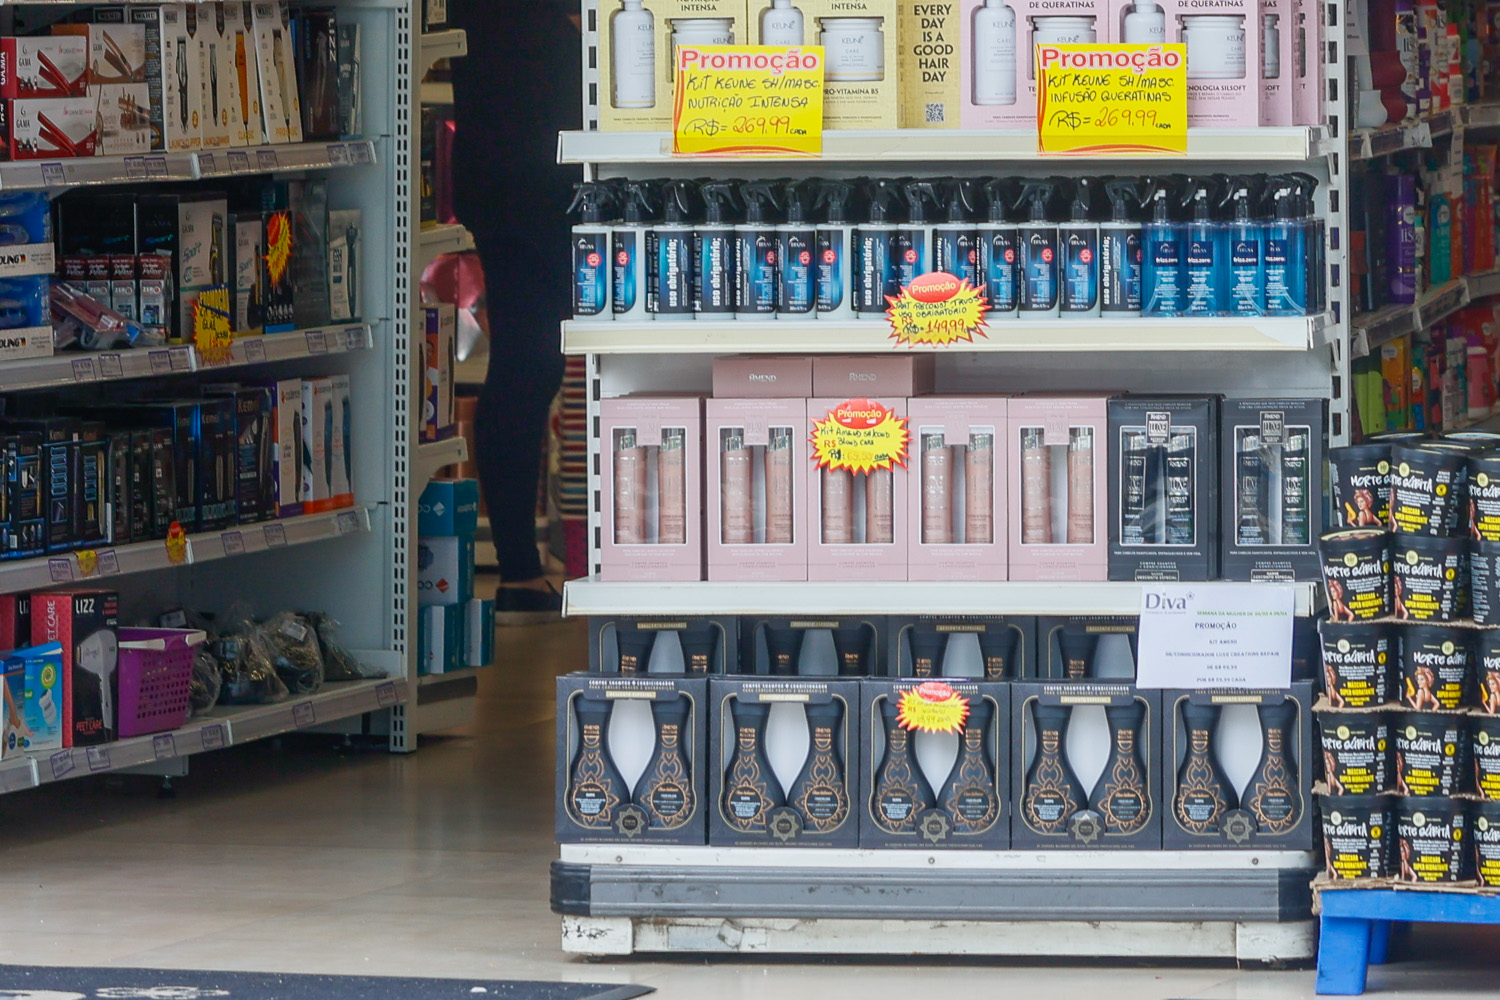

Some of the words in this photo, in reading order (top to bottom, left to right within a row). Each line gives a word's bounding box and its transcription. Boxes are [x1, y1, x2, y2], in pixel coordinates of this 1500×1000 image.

[914, 4, 951, 16] EVERY
[1029, 1, 1039, 9] DE
[1041, 0, 1095, 10] QUERATINAS
[1178, 0, 1188, 8] DE
[1190, 0, 1244, 9] QUERATINAS
[921, 18, 945, 29] DAY
[923, 32, 933, 42] IS
[935, 32, 944, 42] A
[913, 44, 954, 56] GOOD
[681, 50, 817, 74] Promoção
[919, 57, 949, 69] HAIR
[1042, 48, 1179, 72] Promoção
[922, 71, 946, 82] DAY
[1072, 74, 1111, 87] KEUNE
[714, 77, 756, 89] KEUNE
[1051, 87, 1097, 102] INFUSÃO
[748, 96, 808, 109] INTENSA
[912, 282, 956, 294] Promoção
[837, 409, 882, 419] Promoção
[824, 440, 836, 448] R$
[75, 598, 95, 614] LIZZ
[1145, 593, 1186, 609] Diva
[1195, 622, 1237, 630] PROMOÇÃO
